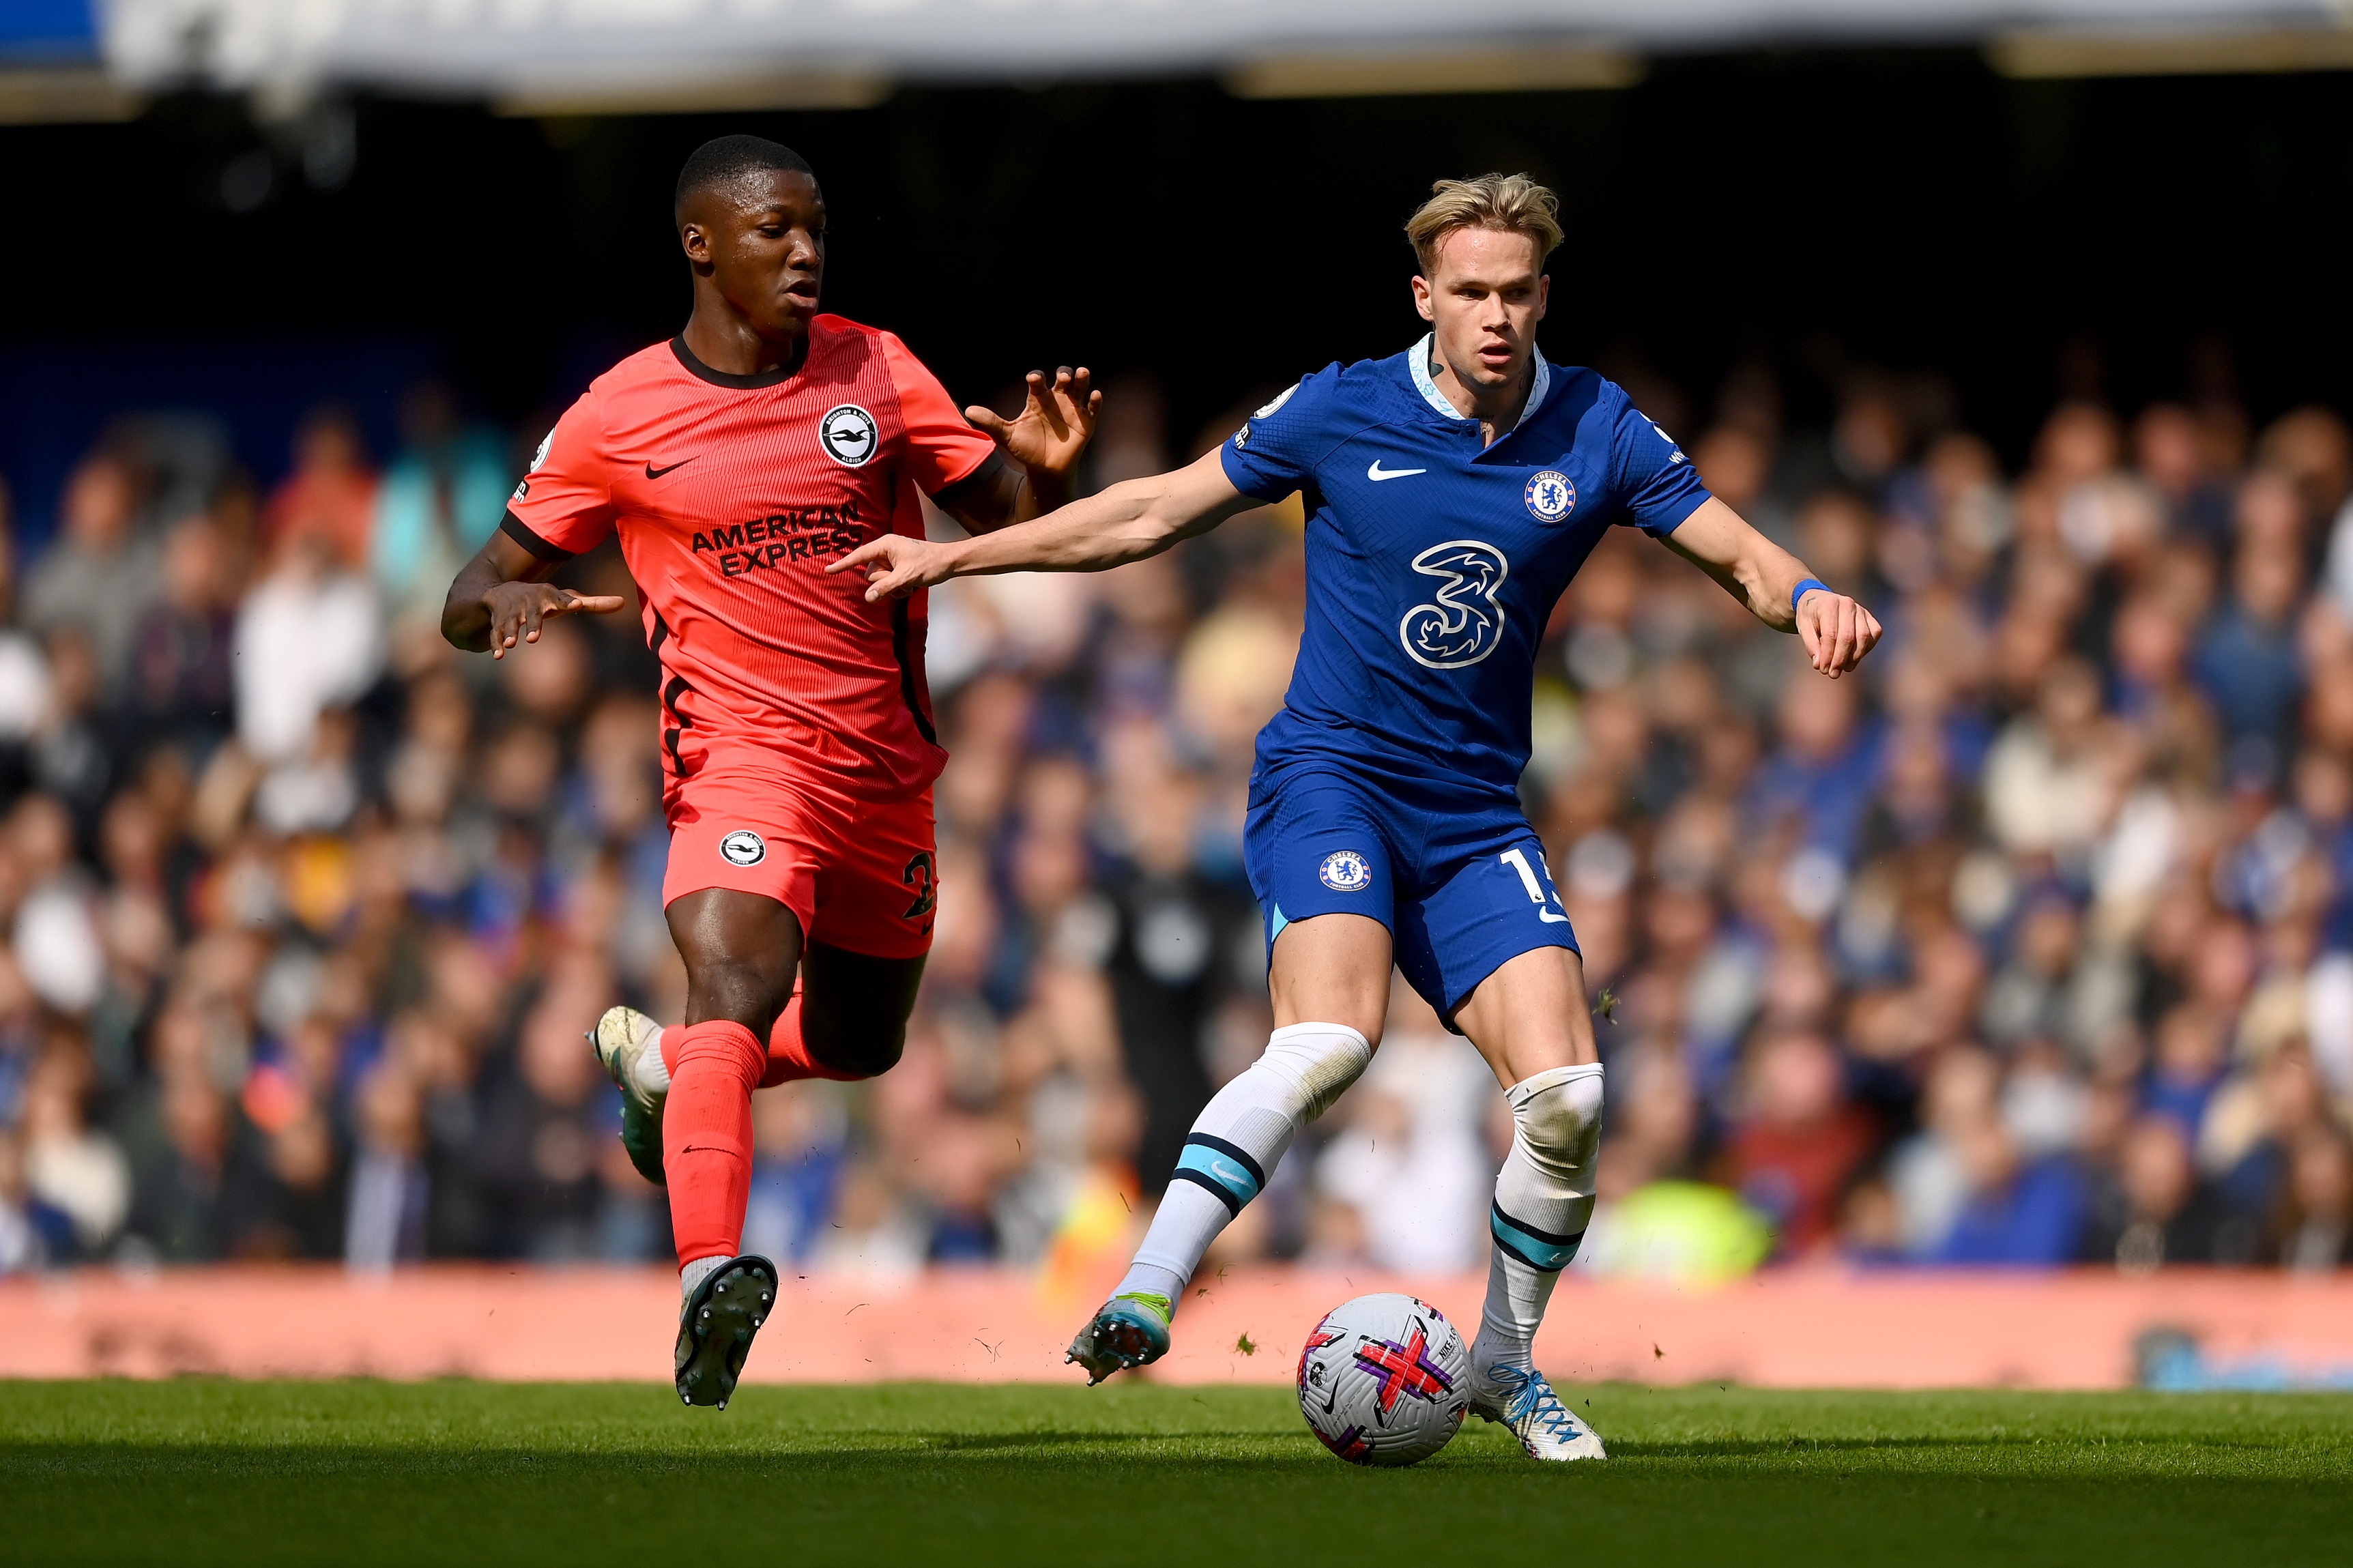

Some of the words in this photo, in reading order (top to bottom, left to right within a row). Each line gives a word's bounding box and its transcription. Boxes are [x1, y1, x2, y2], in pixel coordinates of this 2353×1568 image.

[826, 409, 851, 425] BRIGHTON
[858, 412, 871, 425] HOVE
[1534, 473, 1567, 485] CHELSEA
[1533, 508, 1554, 520] FOOTBALL
[692, 500, 859, 553] AMERICAN
[720, 525, 863, 577] EXPRESS
[1400, 540, 1508, 669] 3
[1327, 852, 1361, 863] CHELSEA
[1439, 1340, 1453, 1360] NIKE
